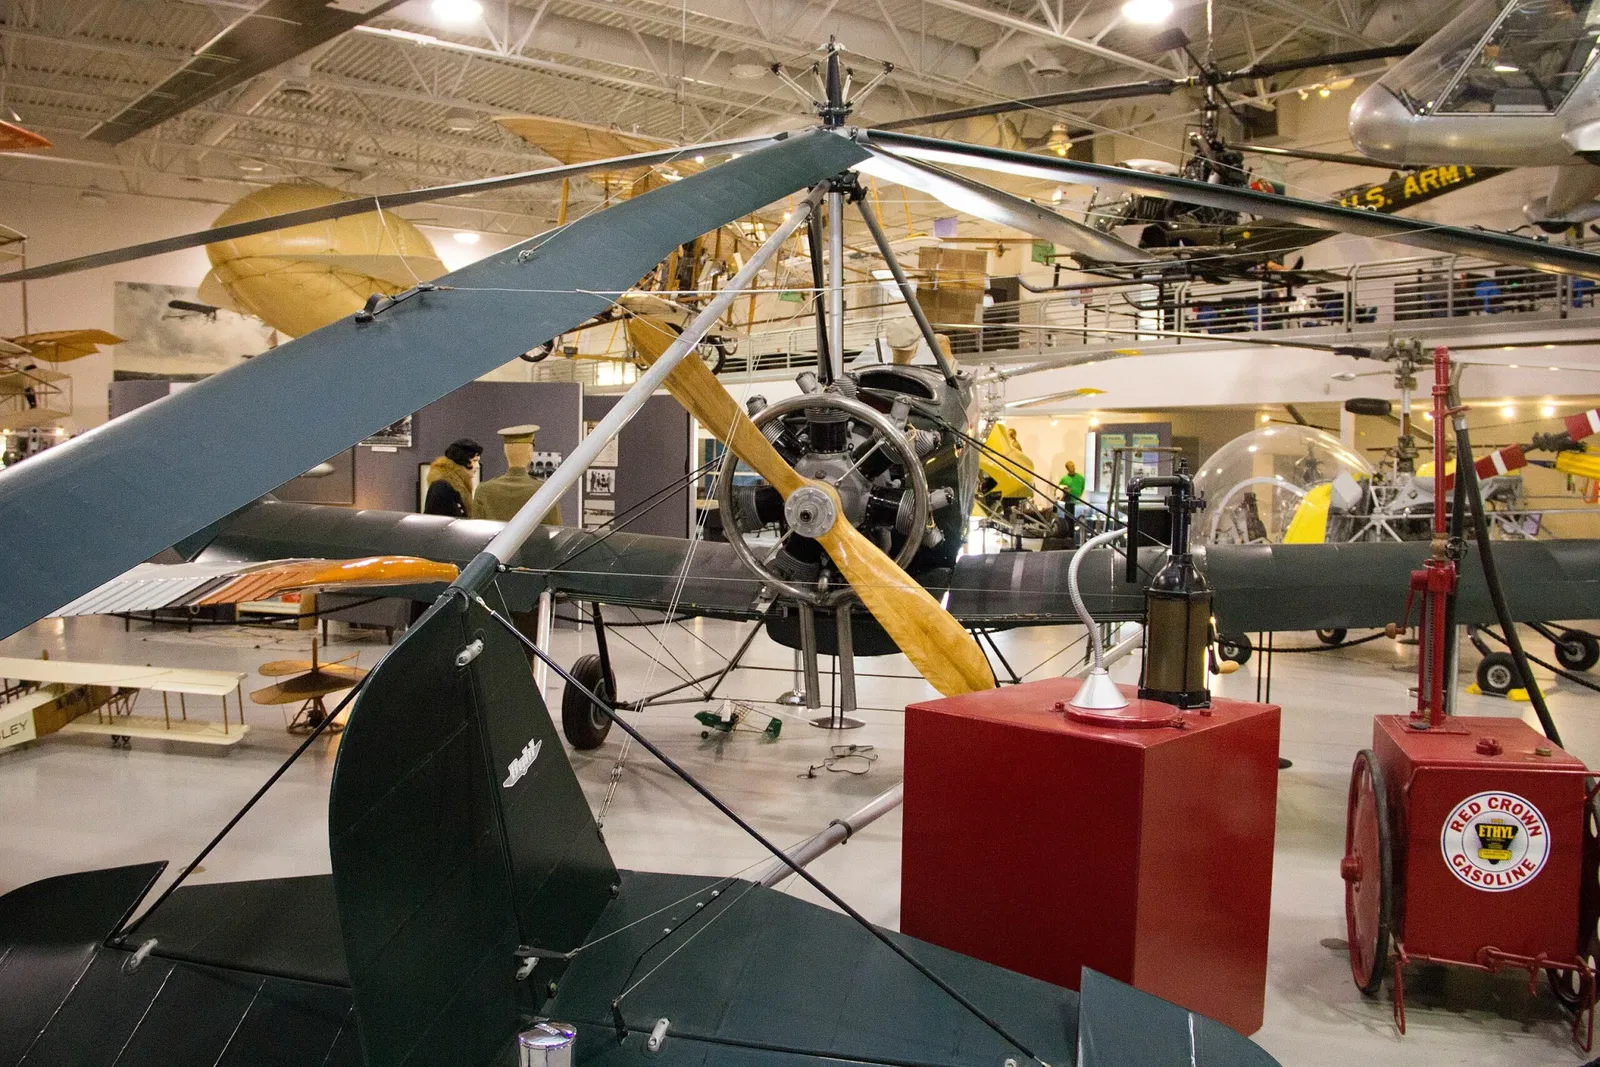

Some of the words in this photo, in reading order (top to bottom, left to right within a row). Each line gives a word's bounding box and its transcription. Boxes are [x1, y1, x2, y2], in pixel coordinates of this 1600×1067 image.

[1340, 186, 1393, 208] US.
[0, 719, 28, 739] LEY
[1450, 802, 1481, 833] RED
[1487, 797, 1542, 837] CROWN
[1478, 824, 1515, 839] ETHYL
[1452, 853, 1536, 886] GASOLINE
